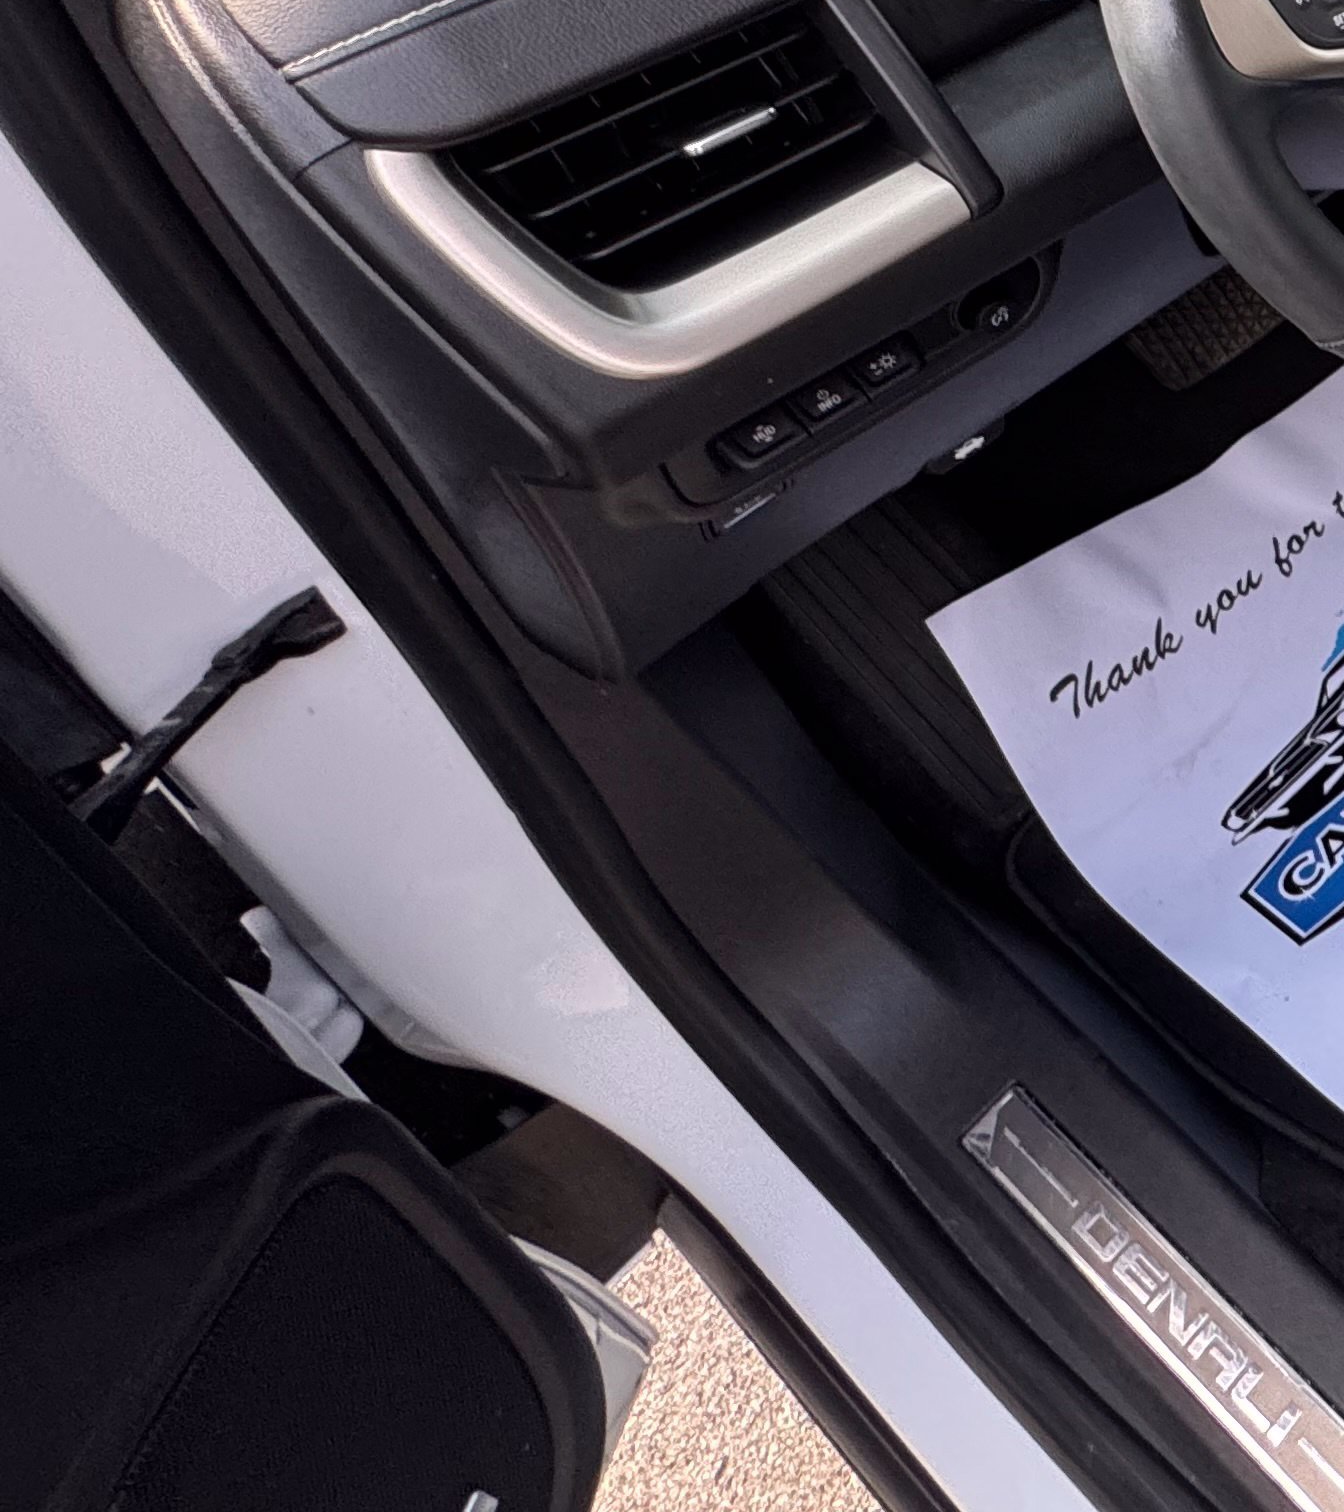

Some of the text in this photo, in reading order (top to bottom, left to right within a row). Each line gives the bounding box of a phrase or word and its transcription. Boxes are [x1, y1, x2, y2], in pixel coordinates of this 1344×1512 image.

[752, 424, 776, 443] HUD
[817, 395, 842, 412] INFO
[1049, 616, 1183, 718] Thank
[1195, 569, 1263, 635] you
[1272, 519, 1325, 577] for
[1071, 1203, 1303, 1449] DENALI
